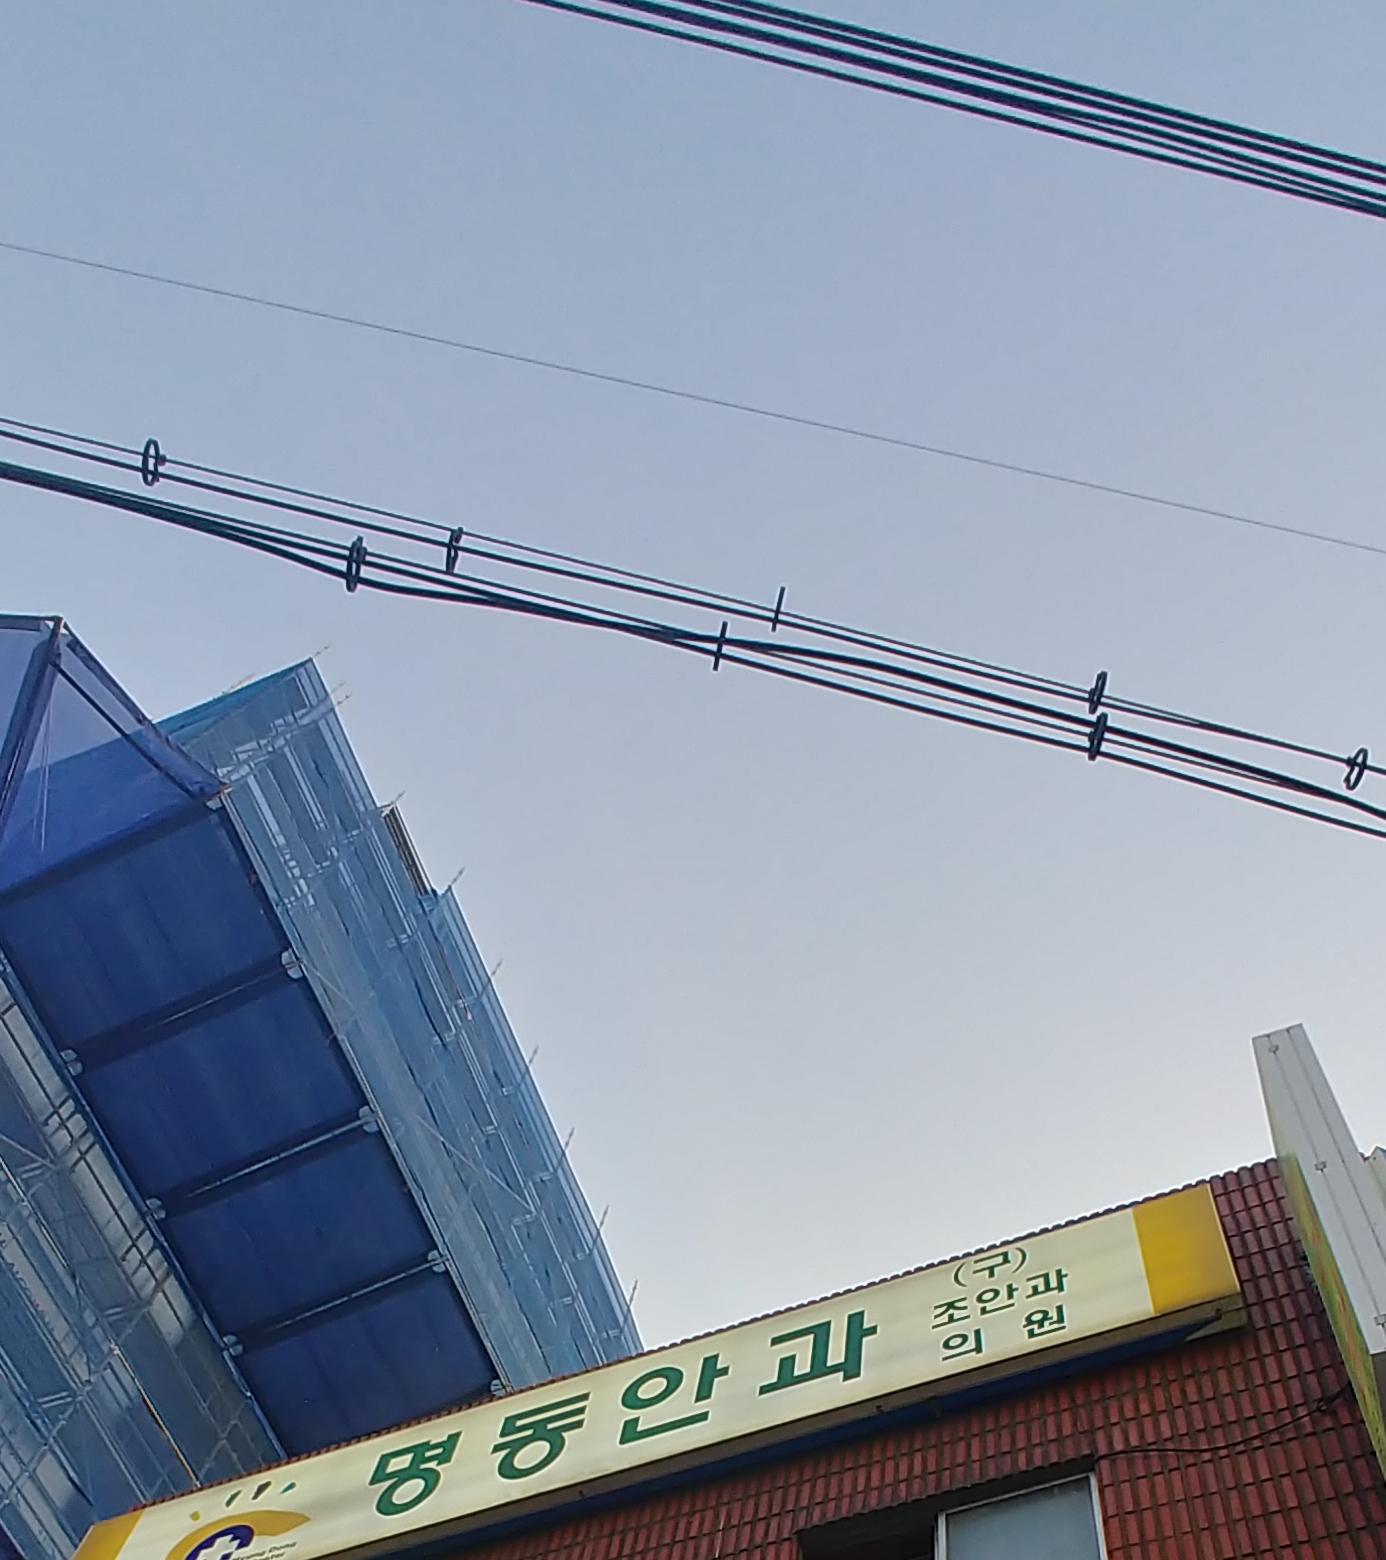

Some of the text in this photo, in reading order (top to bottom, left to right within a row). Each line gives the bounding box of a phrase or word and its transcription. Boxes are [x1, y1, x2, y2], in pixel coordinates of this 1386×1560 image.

[953, 1247, 1027, 1288] (구)
[932, 1268, 1069, 1330] 조안과
[941, 1304, 1067, 1362] 의원
[368, 1309, 880, 1518] 명동안과
